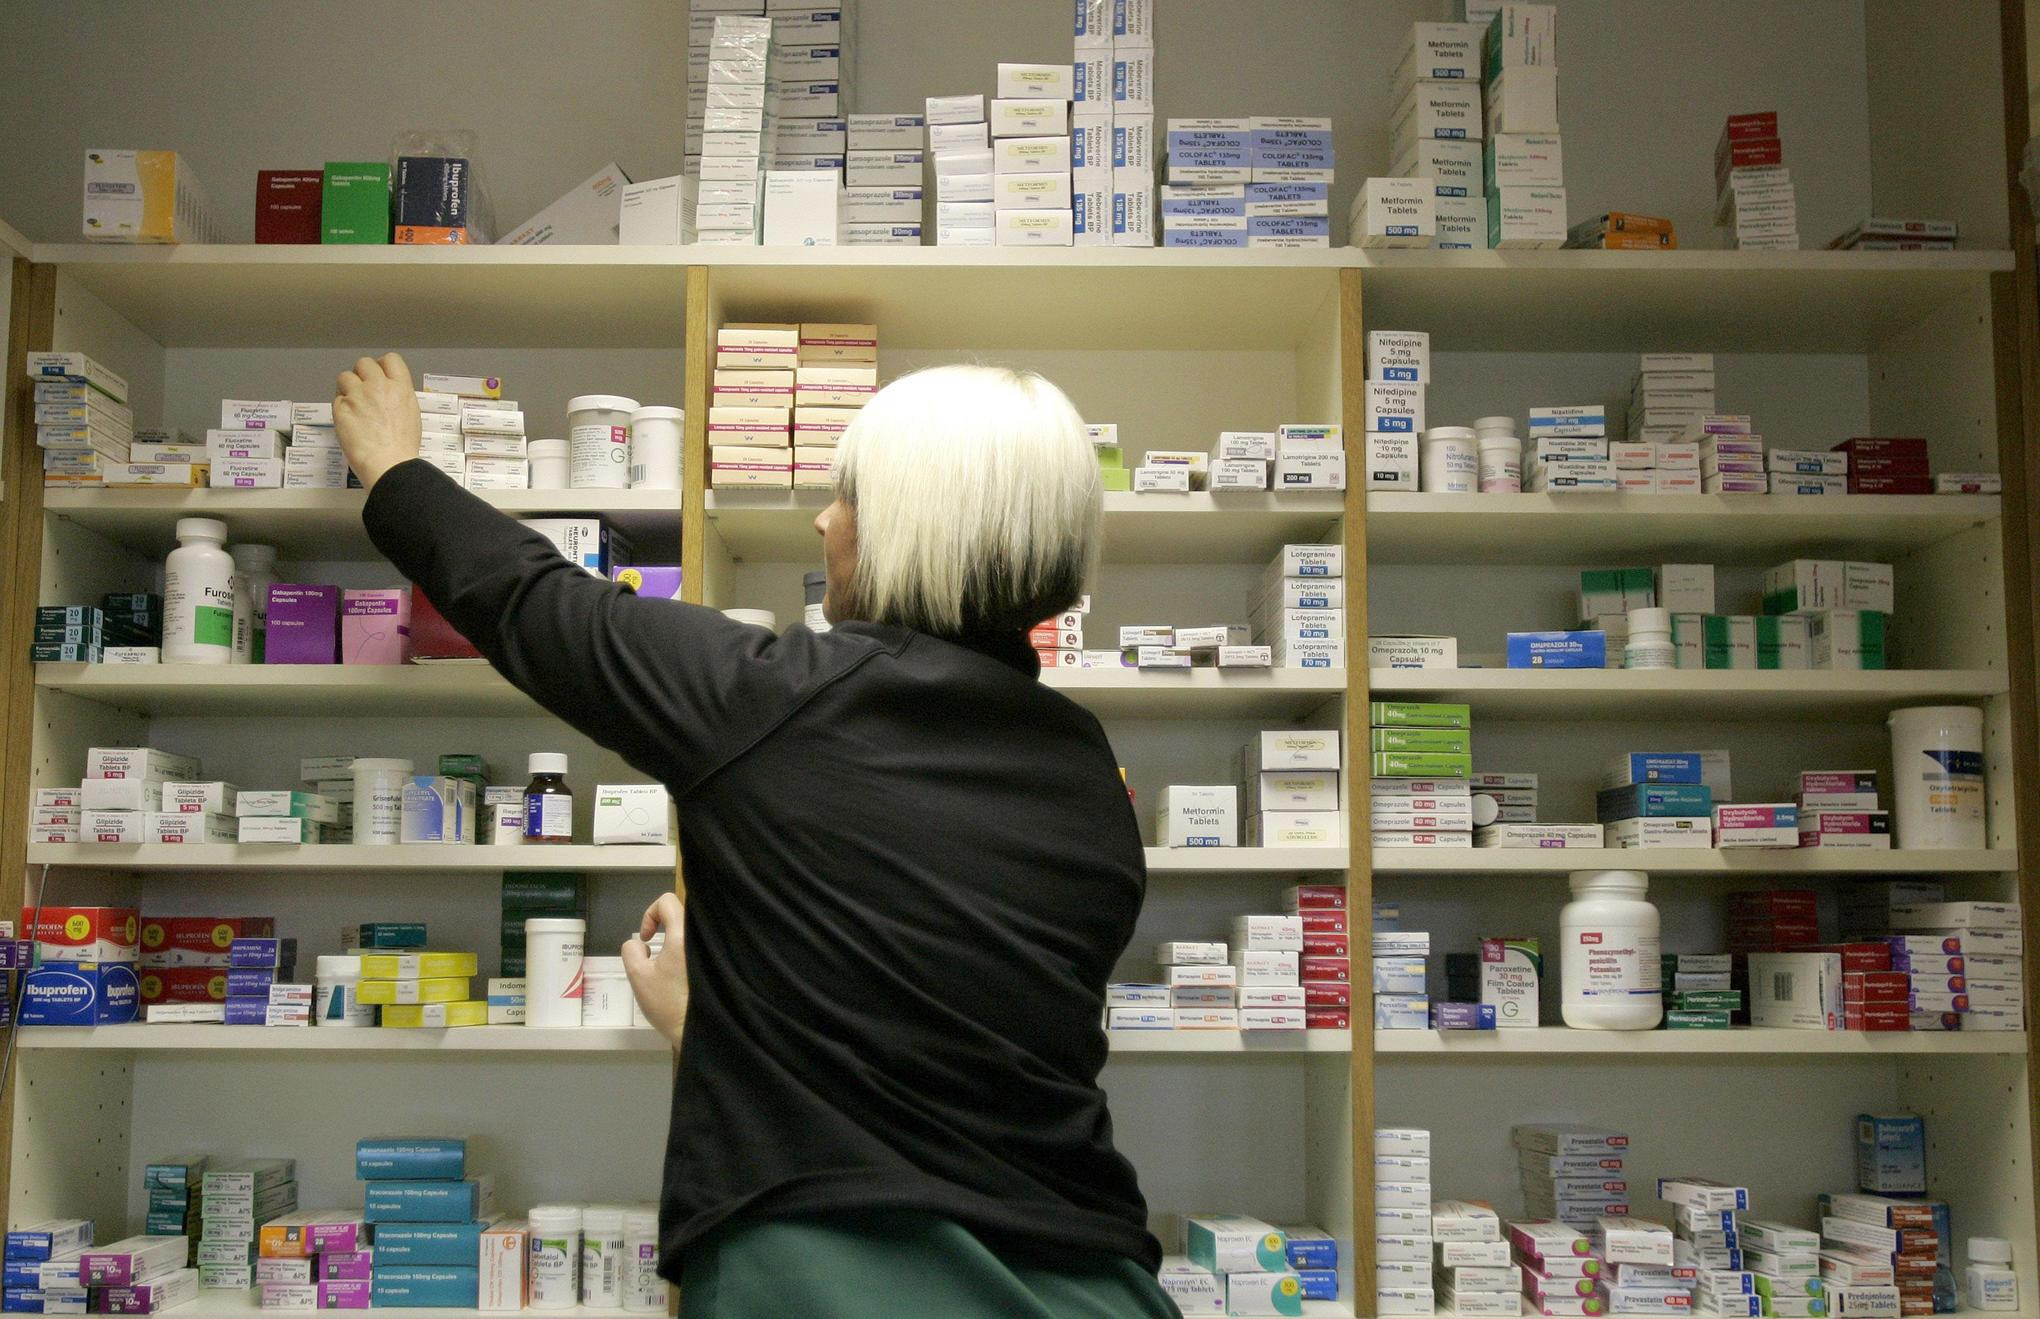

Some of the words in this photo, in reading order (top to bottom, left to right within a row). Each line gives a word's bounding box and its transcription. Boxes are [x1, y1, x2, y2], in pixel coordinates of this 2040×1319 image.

[1428, 41, 1469, 49] Metformin
[1433, 50, 1463, 58] Tablets
[1434, 69, 1449, 77] 500
[1451, 70, 1464, 78] mg
[1429, 100, 1470, 109] Metformin
[1435, 109, 1465, 118] Tablets
[1435, 129, 1450, 137] 500
[1452, 130, 1465, 138] mg
[1087, 156, 1094, 166] BP
[1127, 156, 1134, 166] BP
[1194, 159, 1226, 167] TABLETS
[451, 162, 463, 217] Ibuprofen
[1380, 196, 1424, 205] Metformin
[1386, 206, 1418, 215] Tablets
[1435, 215, 1477, 223] Metformin
[1387, 226, 1403, 234] 500
[1404, 227, 1418, 236] mg
[1440, 224, 1471, 233] Tablets
[1378, 338, 1422, 349] Nifedipine
[1389, 348, 1396, 356] 5
[1380, 357, 1420, 367] Capsules
[1389, 370, 1396, 378] 5
[1397, 372, 1412, 380] mg
[1373, 387, 1417, 398] Nifedipine
[1384, 397, 1391, 405] 5
[1392, 399, 1406, 407] mg
[1375, 406, 1415, 416] Capsules
[1384, 419, 1390, 427] 5
[1392, 421, 1407, 429] mg
[1373, 438, 1409, 447] Nifedipine
[1381, 445, 1390, 453] 10
[1391, 446, 1403, 454] mg
[1375, 452, 1409, 461] Capsules
[1300, 460, 1322, 468] Tablets
[1285, 474, 1298, 482] 200
[1298, 475, 1309, 483] mg
[1290, 551, 1336, 560] Lofepramine
[1300, 558, 1327, 566] Tablets
[271, 597, 298, 605] Capsules
[69, 609, 80, 618] 20
[68, 629, 79, 638] 20
[1293, 643, 1338, 652] Lofepramine
[1371, 646, 1419, 656] Omeprazole
[1431, 648, 1444, 657] mg
[1303, 651, 1329, 659] Tablets
[1389, 656, 1426, 665] Capsules
[1532, 656, 1543, 665] 28
[102, 755, 129, 764] Glipizide
[99, 764, 121, 772] Tablets
[121, 764, 131, 772] BP
[177, 789, 205, 797] Glipizide
[175, 797, 197, 805] Tablets
[1414, 800, 1424, 808] 40
[1424, 801, 1435, 810] mg
[1439, 800, 1467, 809] Capsules
[1182, 806, 1225, 815] Metformin
[96, 818, 123, 827] Glipizide
[1188, 817, 1220, 826] Tablets
[92, 827, 115, 835] Tablets
[107, 835, 117, 843] mg
[1506, 831, 1545, 841] Omeprazole
[1567, 832, 1597, 841] Capsules
[1188, 837, 1204, 846] 500
[26, 924, 64, 932] IBPROFEN
[1488, 951, 1502, 960] mg
[1489, 964, 1533, 974] Paroxetine
[1510, 974, 1523, 982] mg
[1487, 980, 1505, 988] Film
[1506, 980, 1535, 989] Coated
[26, 984, 88, 998] Ibuprofen
[422, 1189, 449, 1198] Capsules
[432, 1231, 458, 1240] Capsules
[1623, 1295, 1663, 1304] Pravastatin
[1677, 1297, 1689, 1306] mg
[1847, 1292, 1896, 1302] Prednisolone
[1870, 1301, 1897, 1309] Tablets
